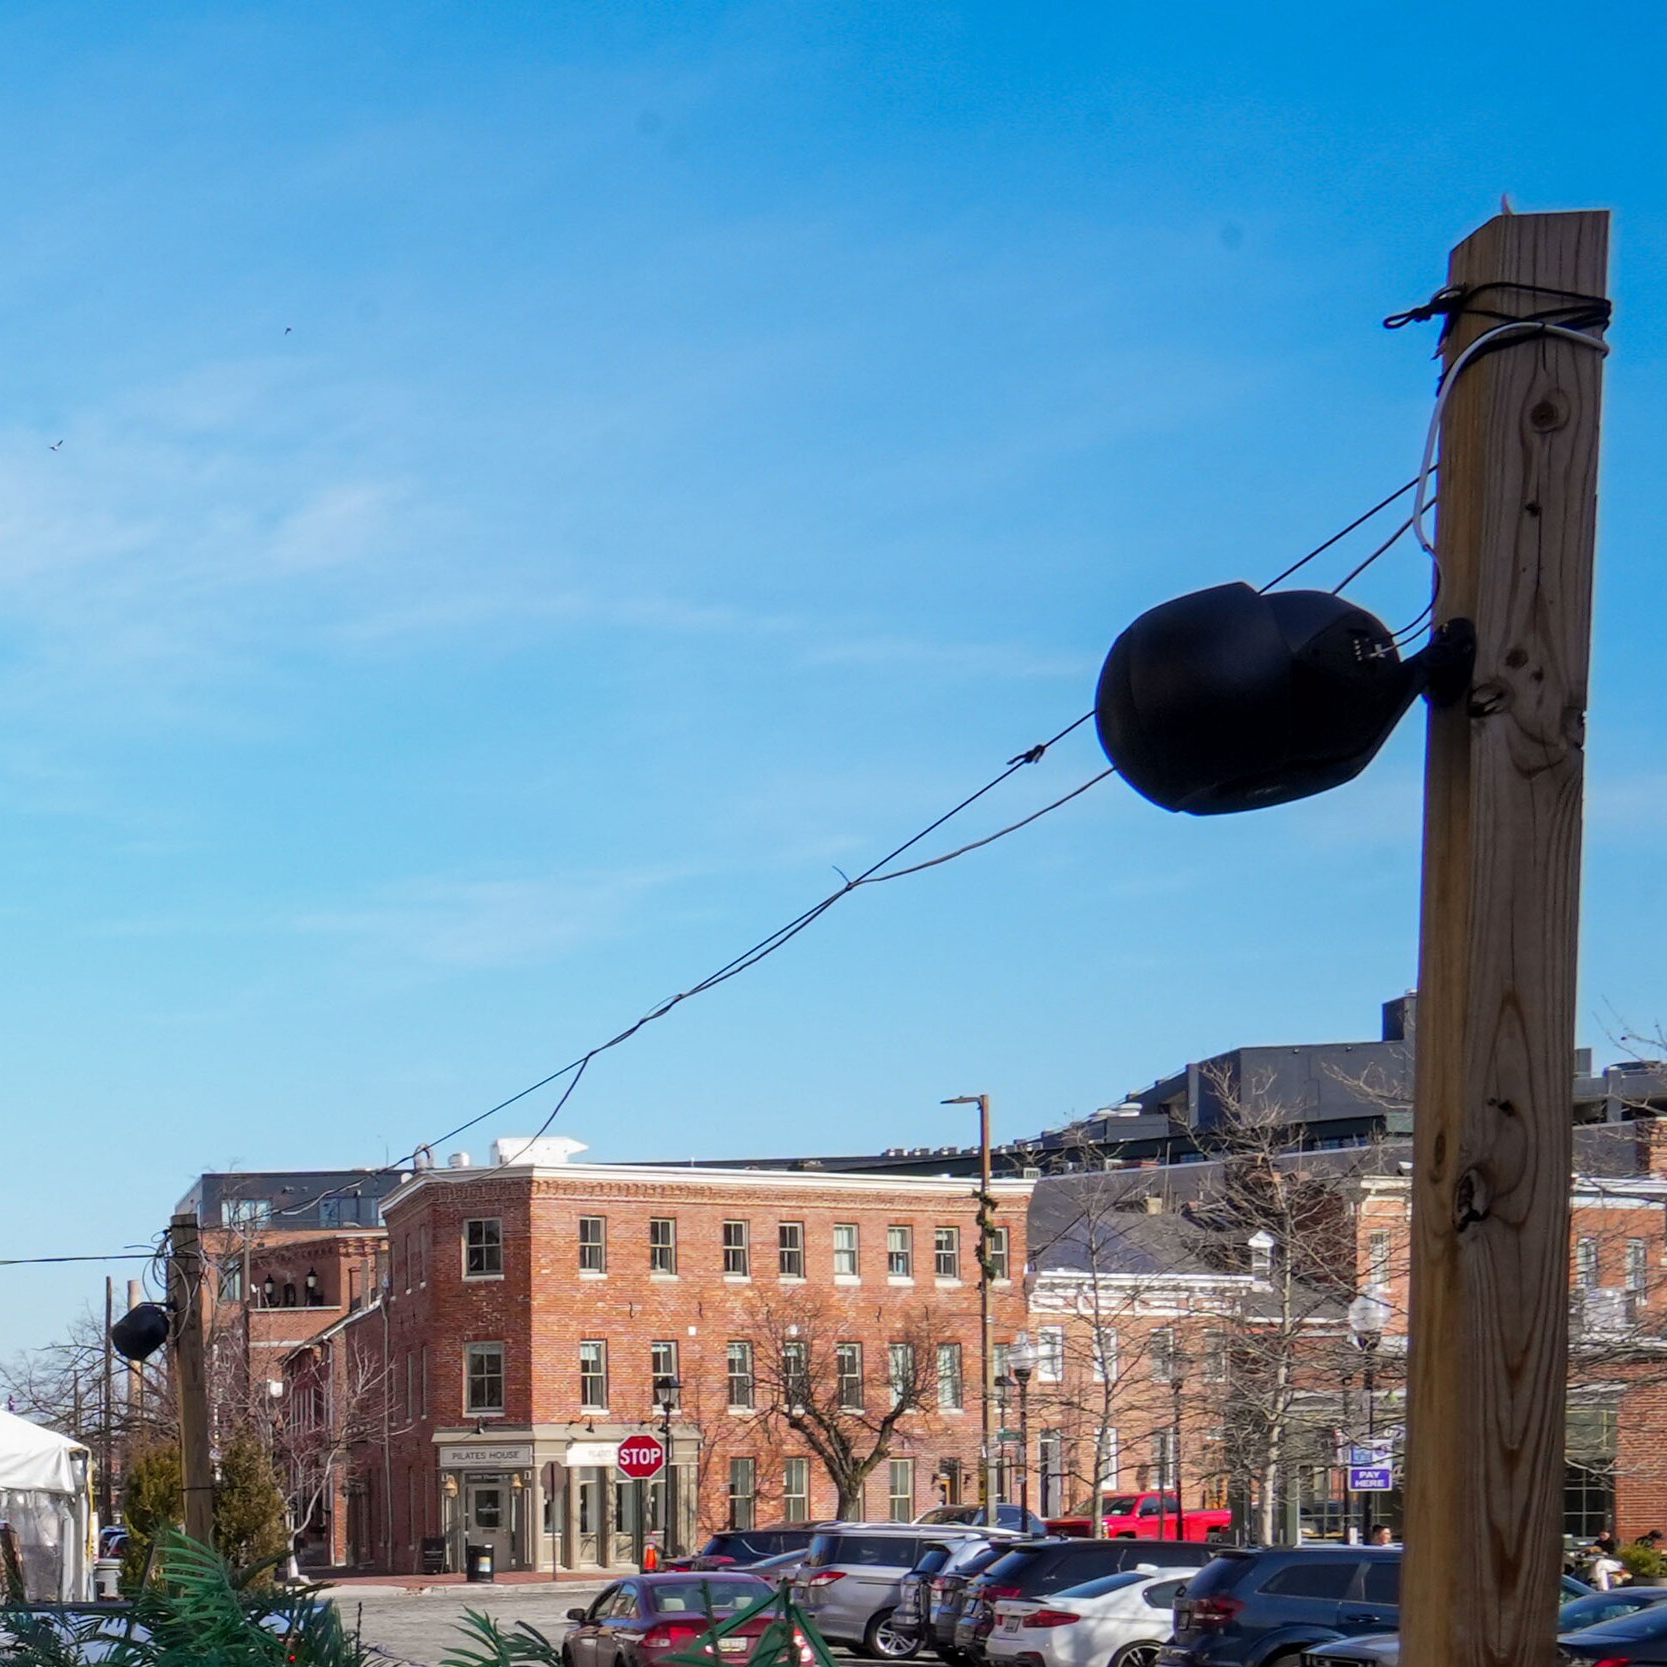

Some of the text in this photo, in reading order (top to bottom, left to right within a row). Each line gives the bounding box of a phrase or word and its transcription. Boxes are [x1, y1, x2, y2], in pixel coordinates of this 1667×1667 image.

[452, 1450, 520, 1460] PILATES HOUSE
[620, 1448, 661, 1465] STOP
[1355, 1479, 1385, 1487] HERE
